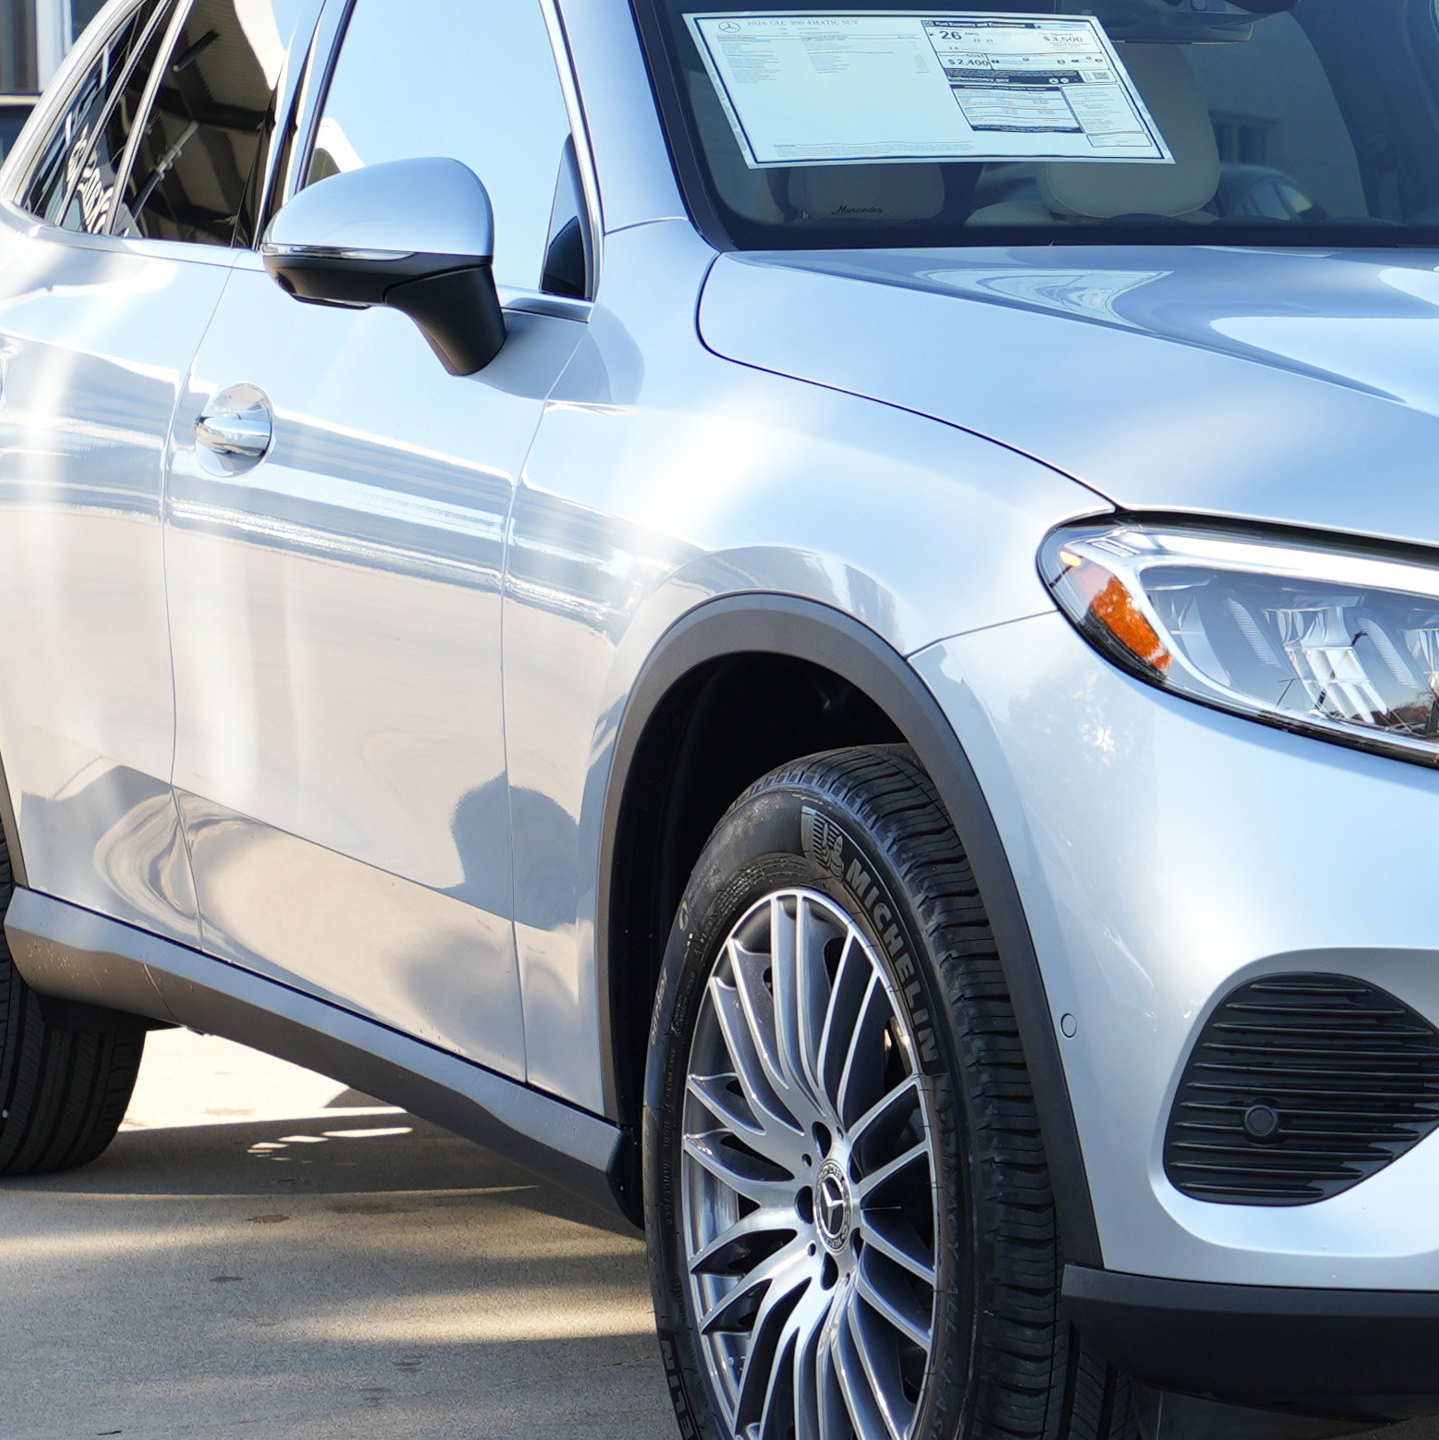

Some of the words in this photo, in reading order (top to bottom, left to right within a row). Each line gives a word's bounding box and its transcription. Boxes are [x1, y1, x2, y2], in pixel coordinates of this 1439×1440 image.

[939, 30, 962, 40] 26
[845, 857, 938, 1062] MICHELIN
[944, 1278, 959, 1333] ALL
